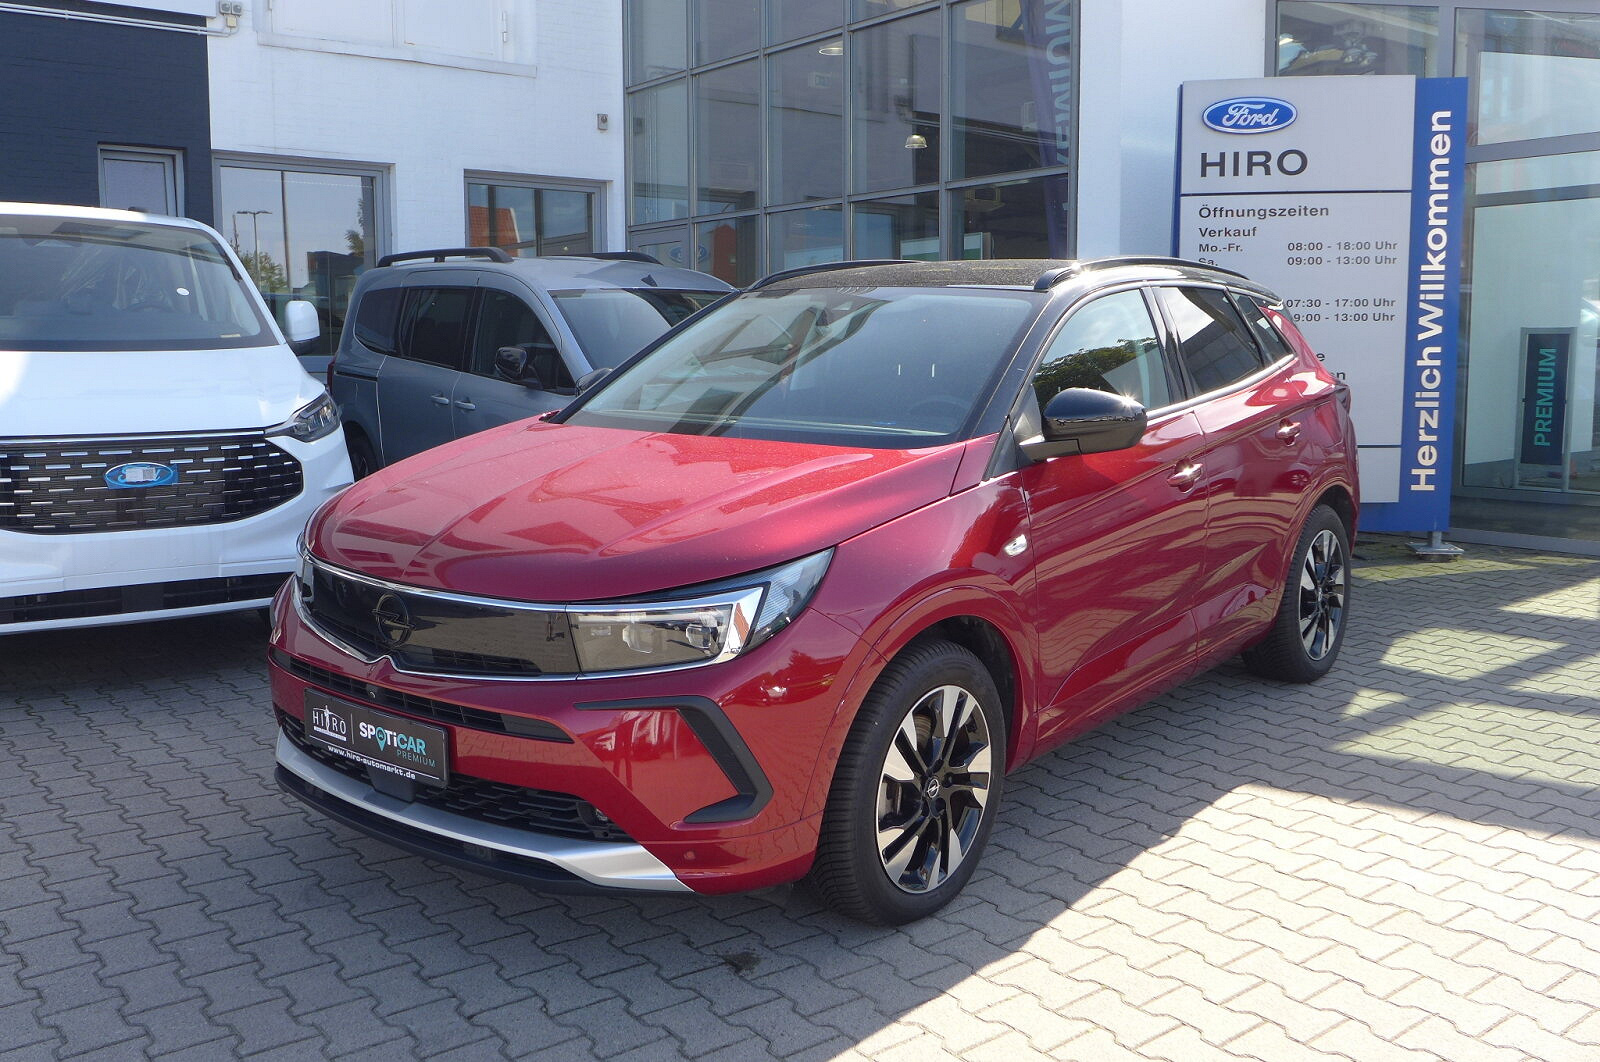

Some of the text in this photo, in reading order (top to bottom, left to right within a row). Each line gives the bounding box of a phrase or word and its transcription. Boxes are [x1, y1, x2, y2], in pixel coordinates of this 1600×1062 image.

[1222, 103, 1279, 127] Ford
[1200, 149, 1308, 178] HIRO
[1198, 203, 1330, 220] Öffnungszeiten
[1198, 226, 1257, 238] Verkauf
[1198, 243, 1244, 253] Mo.-Fr.
[1287, 242, 1323, 251] 08:00
[1336, 241, 1371, 250] 18:00
[1375, 240, 1399, 250] Uhr
[1287, 256, 1323, 265] 09:00
[1335, 256, 1370, 265] 13:00
[1375, 255, 1398, 265] Uhr
[1286, 299, 1321, 308] 07:30
[1334, 298, 1369, 308] 17:00
[1373, 298, 1397, 307] Uhr
[1410, 110, 1452, 491] Herzlich Willkommen
[1293, 313, 1321, 322] 9:00
[1334, 313, 1368, 322] 13:00
[1372, 312, 1396, 322] Uhr
[1534, 348, 1557, 446] PREMIUM
[312, 710, 347, 734] HIRO
[327, 745, 416, 780] www.hiro-automarkt.de
[396, 749, 436, 768] PREMIUM
